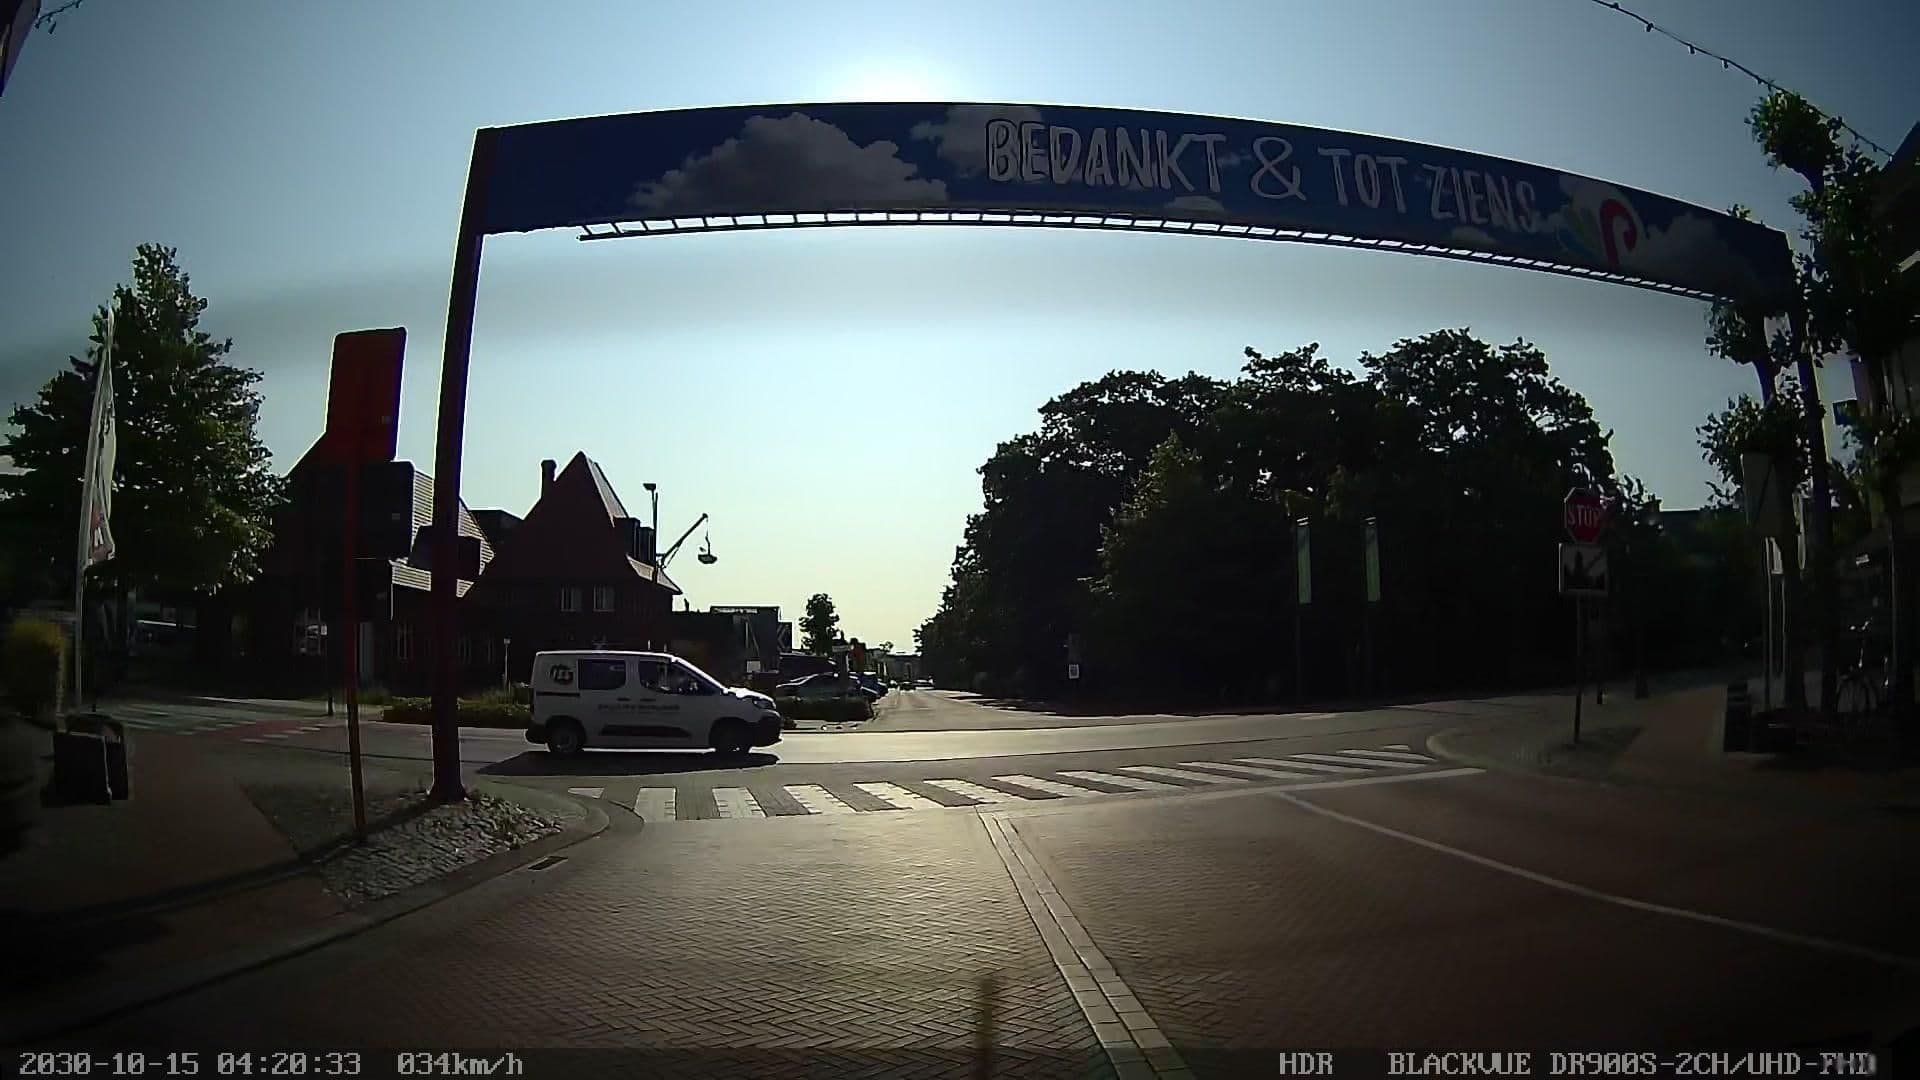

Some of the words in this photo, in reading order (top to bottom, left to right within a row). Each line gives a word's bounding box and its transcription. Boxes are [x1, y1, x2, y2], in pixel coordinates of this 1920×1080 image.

[986, 118, 1226, 193] BEDANKT
[1250, 136, 1307, 201] &
[1317, 147, 1408, 214] TOT
[1422, 163, 1538, 234] ZIENS
[1567, 503, 1603, 527] STOP
